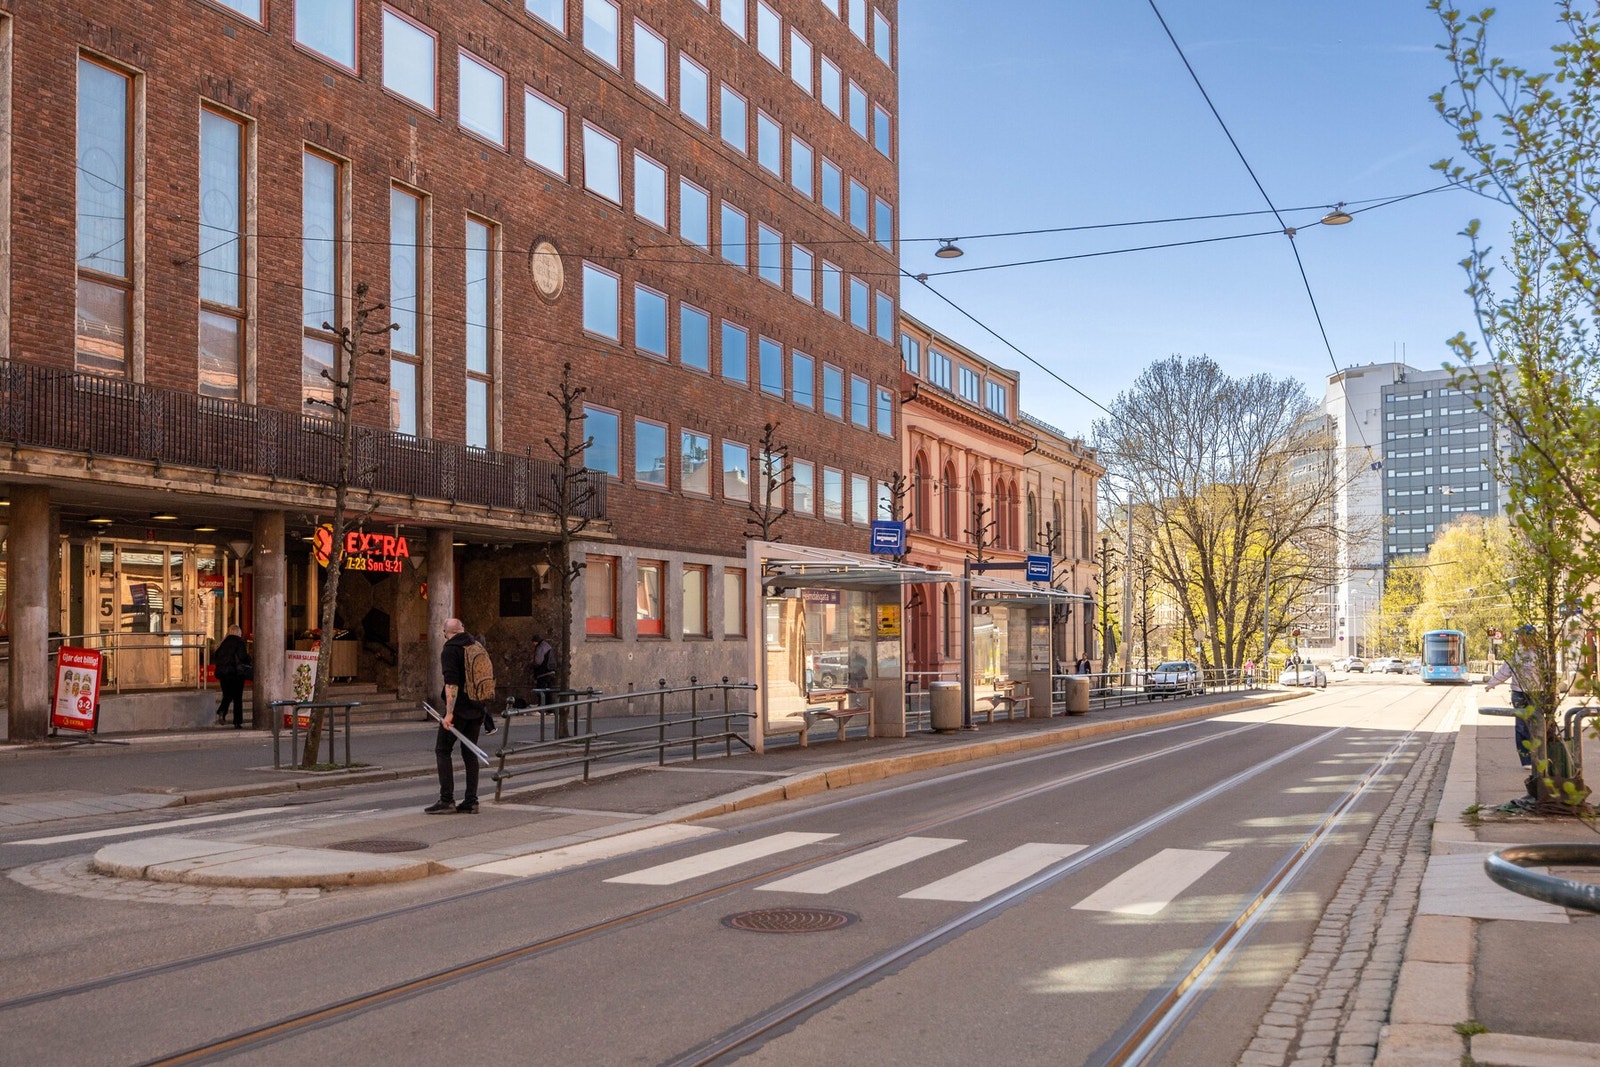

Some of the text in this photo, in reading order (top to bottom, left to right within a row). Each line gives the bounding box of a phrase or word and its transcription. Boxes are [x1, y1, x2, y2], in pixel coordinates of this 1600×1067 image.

[346, 532, 409, 558] EXTRA
[385, 560, 403, 573] 9-21
[100, 597, 113, 617] 5
